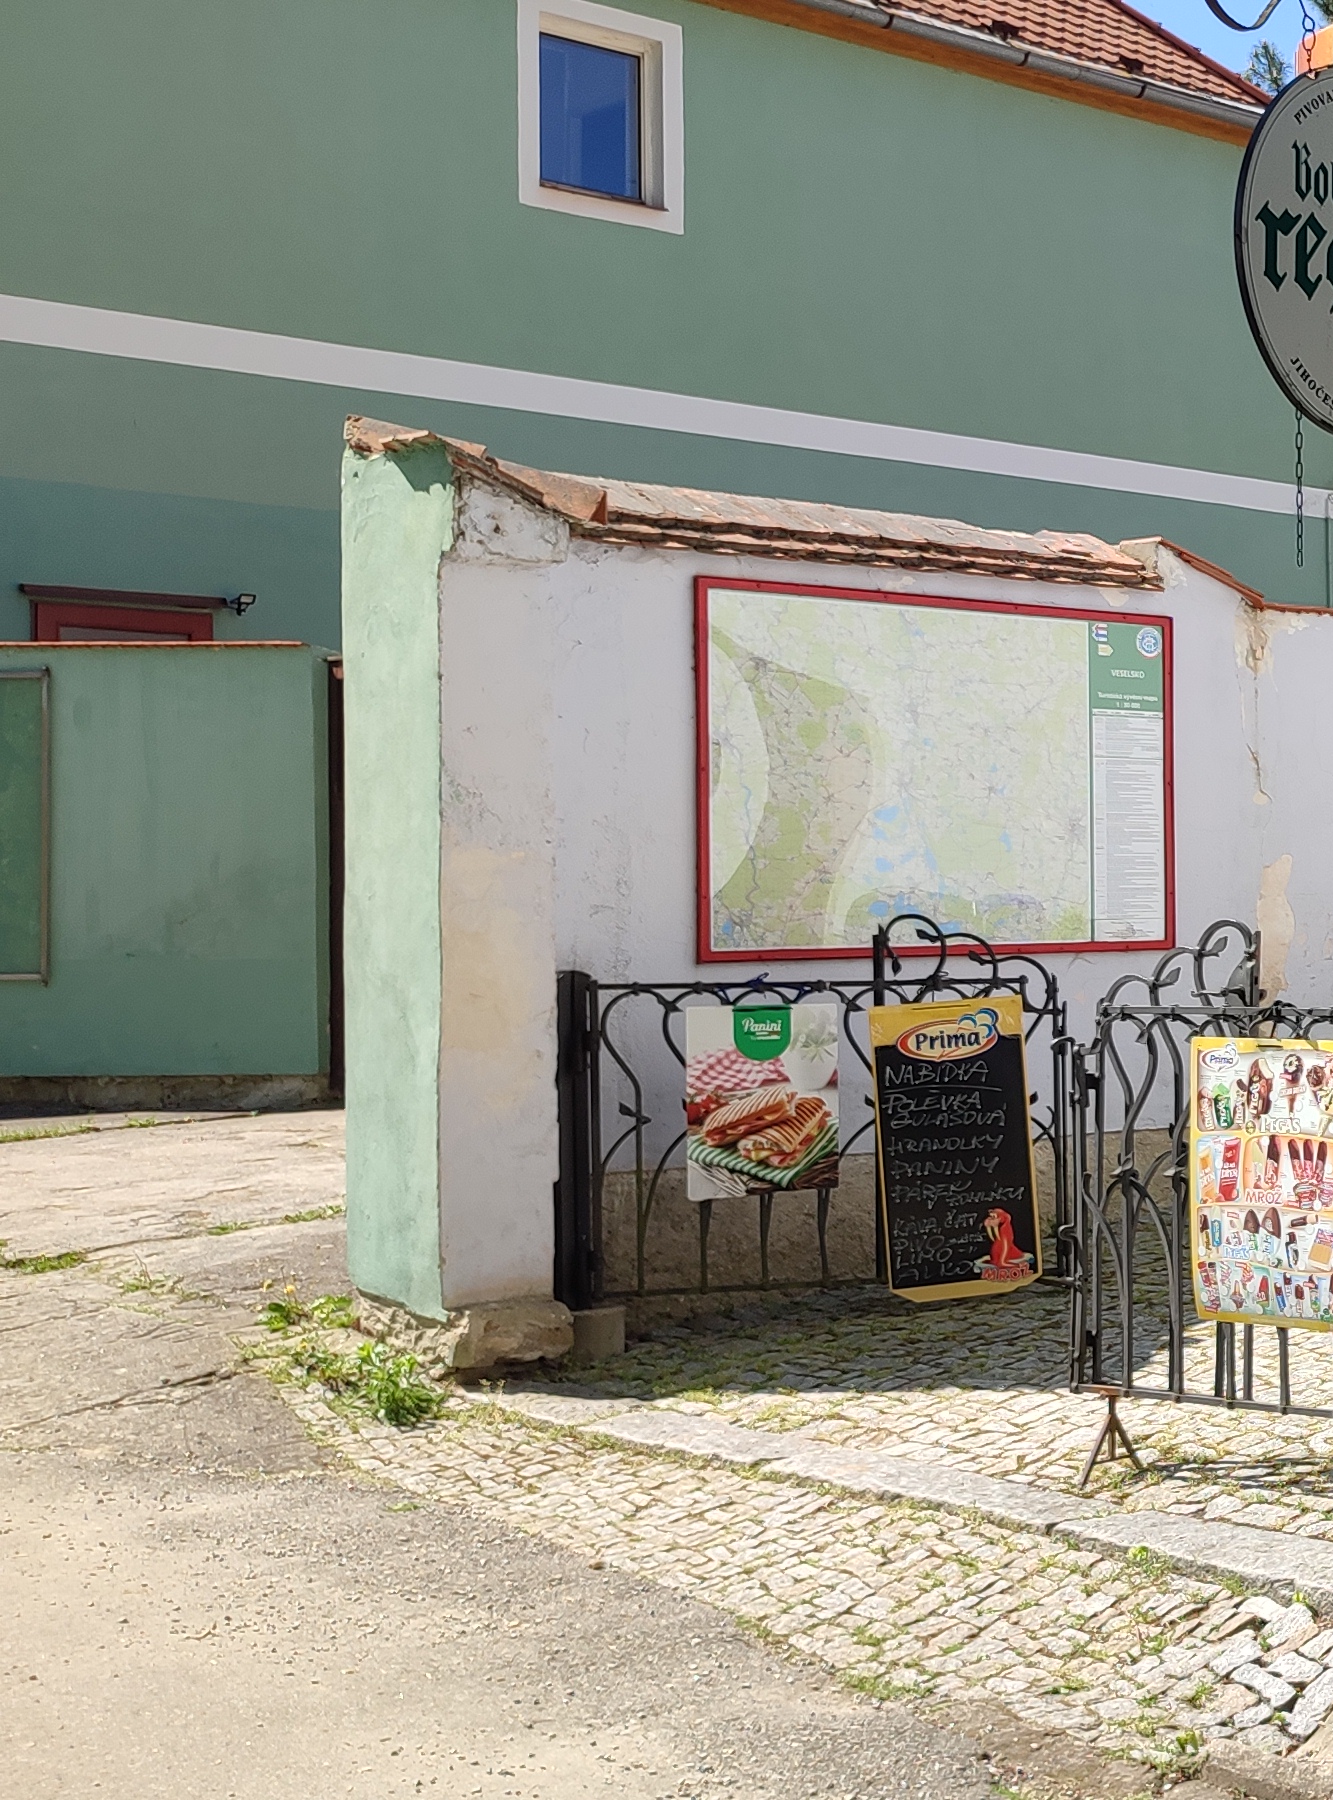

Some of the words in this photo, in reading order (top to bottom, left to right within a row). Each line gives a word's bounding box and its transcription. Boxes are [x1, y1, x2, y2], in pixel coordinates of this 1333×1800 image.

[1110, 670, 1145, 679] VESELSKO
[741, 1016, 782, 1032] Panini
[914, 1030, 982, 1050] Prima
[1210, 1054, 1234, 1065] Prima
[1260, 1116, 1301, 1134] PEGAS
[886, 1134, 1003, 1157] HRANOLKY
[981, 1262, 1034, 1282] MROŽ
